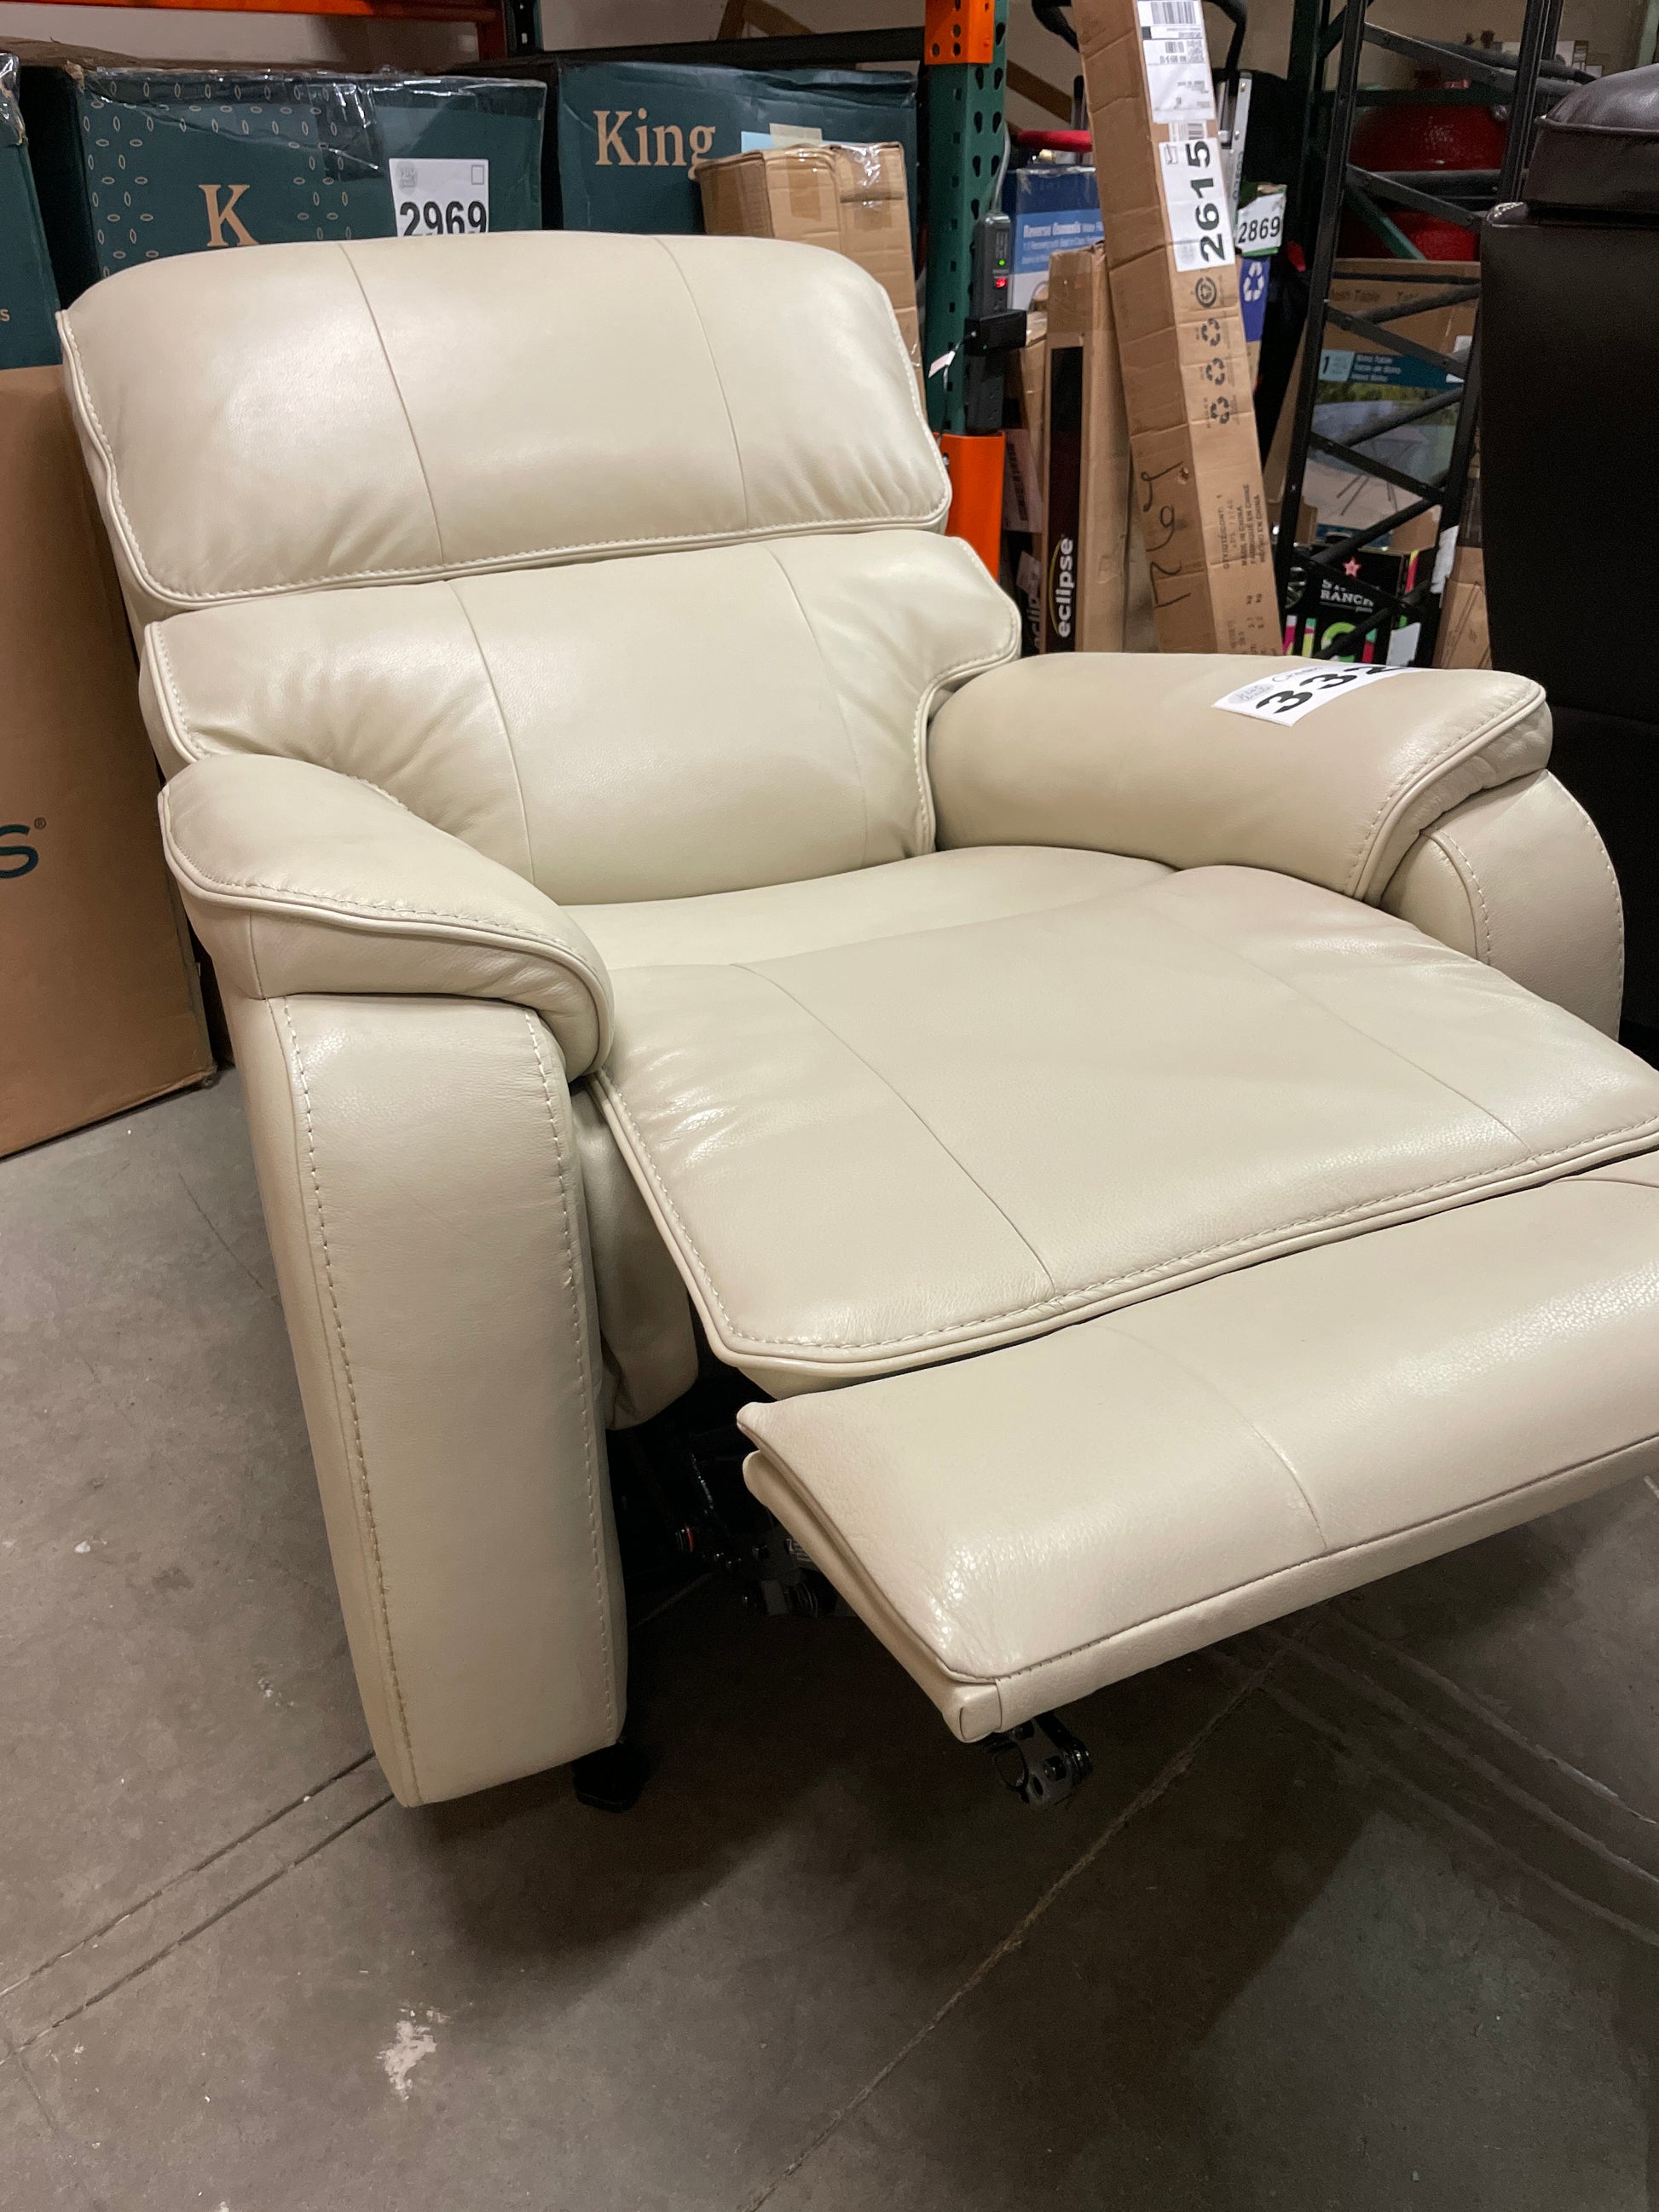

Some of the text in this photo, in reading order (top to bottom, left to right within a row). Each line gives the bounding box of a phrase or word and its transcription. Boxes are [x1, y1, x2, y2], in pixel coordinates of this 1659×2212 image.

[593, 107, 716, 181] King
[199, 184, 259, 246] K
[400, 200, 487, 236] 2969
[1186, 141, 1225, 262] 2615
[1238, 216, 1280, 244] 2869
[1055, 538, 1075, 638] eclipse
